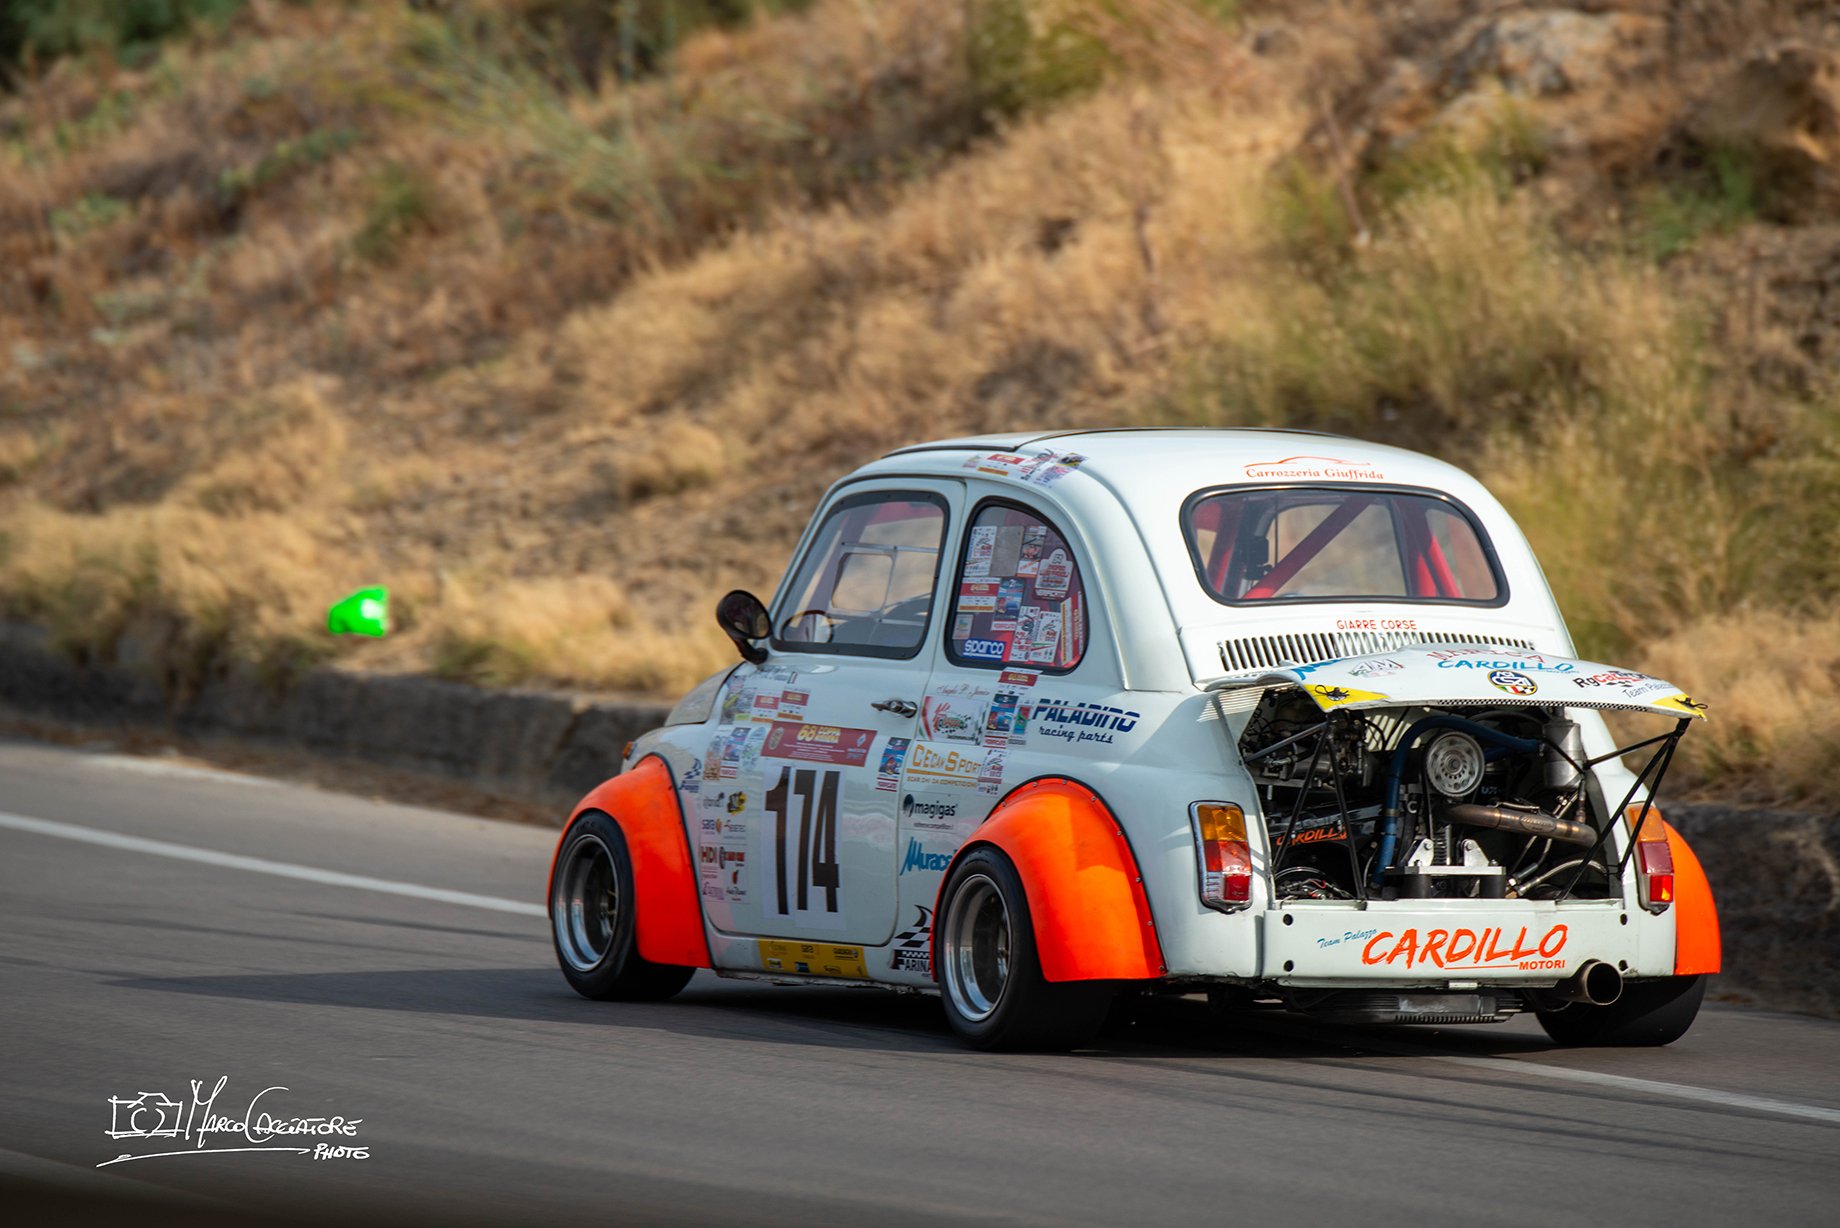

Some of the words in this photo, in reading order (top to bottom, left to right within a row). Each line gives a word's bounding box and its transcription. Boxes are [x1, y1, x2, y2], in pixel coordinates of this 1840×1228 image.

[1246, 468, 1320, 478] Carrozzeria
[1324, 468, 1384, 480] Giuffrida
[1336, 619, 1377, 630] GIARRE
[1380, 619, 1417, 630] CORSE
[965, 638, 1004, 656] sparco
[1437, 659, 1574, 672] CARDILLO
[1622, 686, 1649, 698] Team
[1032, 698, 1140, 732] PALADINO
[797, 724, 817, 742] 68
[1039, 725, 1074, 742] racing
[1077, 730, 1113, 744] parts
[914, 801, 956, 819] magigas
[765, 766, 840, 915] 174
[1317, 936, 1341, 949] Team
[1343, 928, 1377, 944] Palazzo
[1362, 924, 1568, 969] CARDILLO
[1518, 960, 1565, 970] MOTORI
